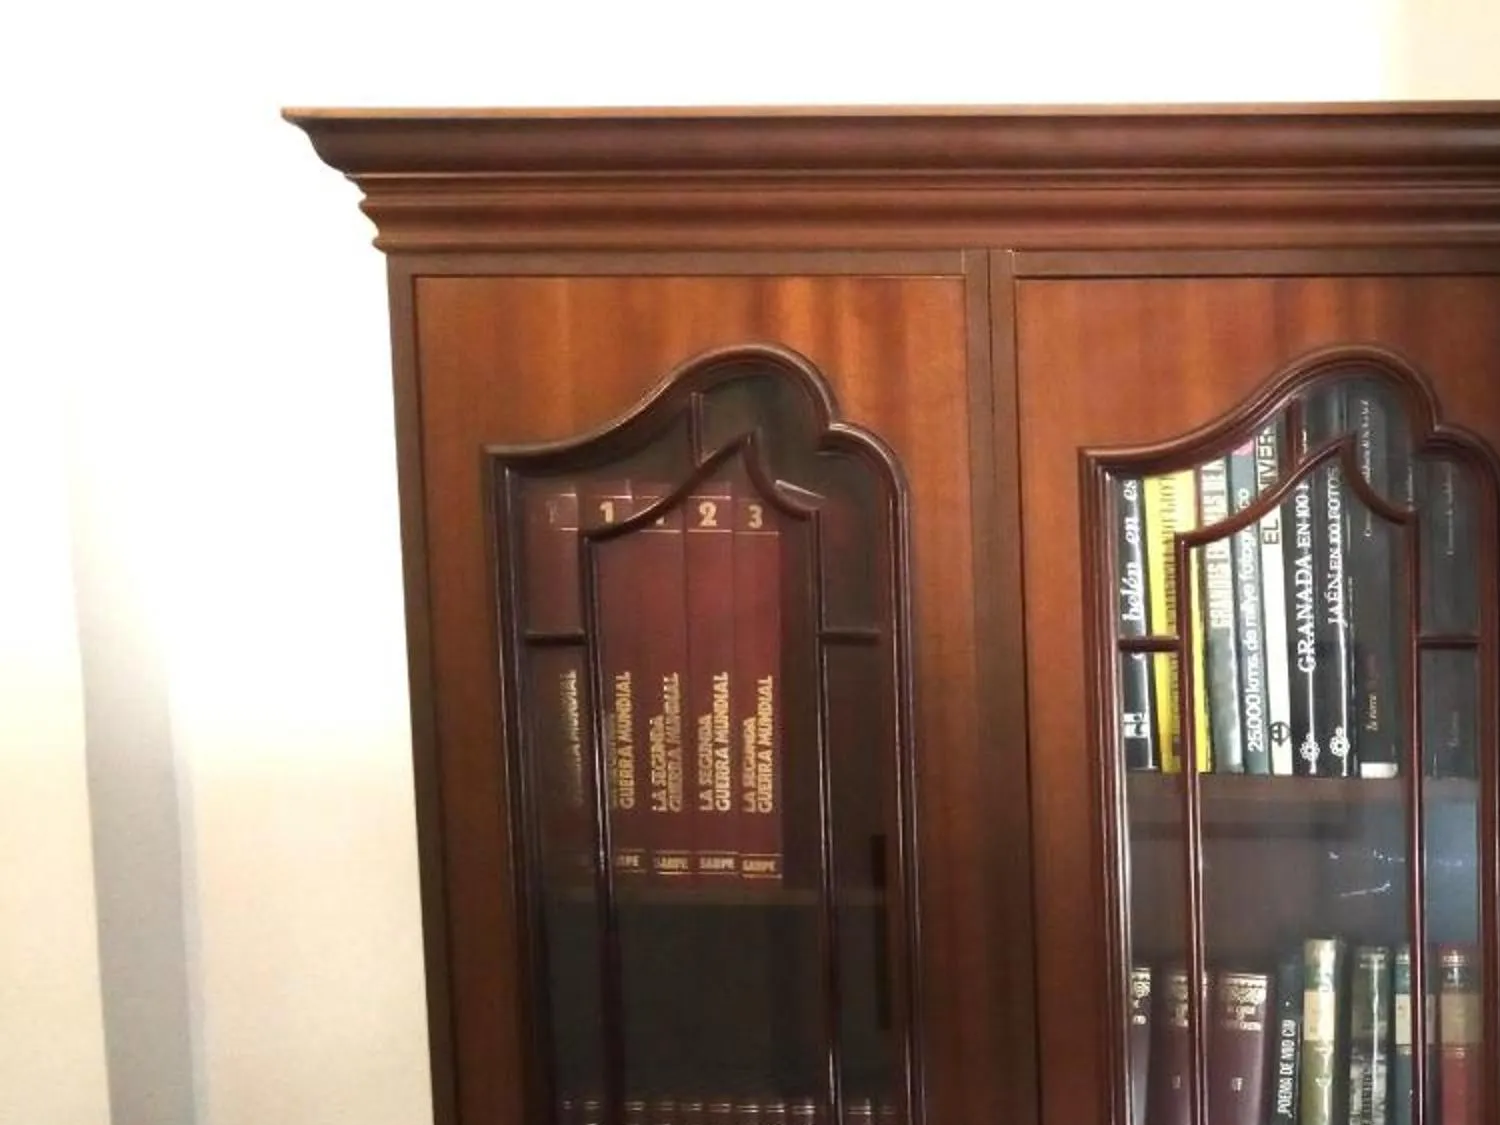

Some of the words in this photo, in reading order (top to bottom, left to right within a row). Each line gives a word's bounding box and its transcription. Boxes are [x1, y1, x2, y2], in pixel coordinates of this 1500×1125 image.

[600, 501, 614, 523] 1
[699, 502, 717, 527] 2
[748, 504, 763, 528] 3
[1296, 494, 1310, 518] 100
[1326, 467, 1341, 520] FOTOS
[1122, 517, 1139, 545] en
[1260, 518, 1279, 545] EL
[1297, 521, 1311, 548] EN
[1329, 547, 1342, 569] EN
[1120, 561, 1142, 621] belén
[1295, 554, 1316, 673] GRANADA
[1324, 573, 1347, 627] JAÉN
[1241, 629, 1257, 650] de
[615, 672, 632, 743] MUNDIAL
[663, 672, 682, 743] MUNDIAL
[713, 672, 730, 743] MUNDIAL
[756, 674, 773, 746] MUNDIAL
[650, 715, 667, 786] SEGUNDA
[698, 714, 713, 785] SEGUNDA
[742, 716, 756, 788] SEGUNDA
[616, 745, 635, 809] GUERRA
[667, 744, 683, 813] GUERRA
[714, 747, 731, 812] GUERRA
[757, 747, 774, 814] GUERRA
[651, 790, 667, 813] LA
[699, 790, 713, 812] LA
[742, 790, 756, 813] LA
[1279, 1061, 1294, 1075] DE
[1280, 1039, 1295, 1061] MIO
[1277, 1077, 1293, 1114] POEMA
